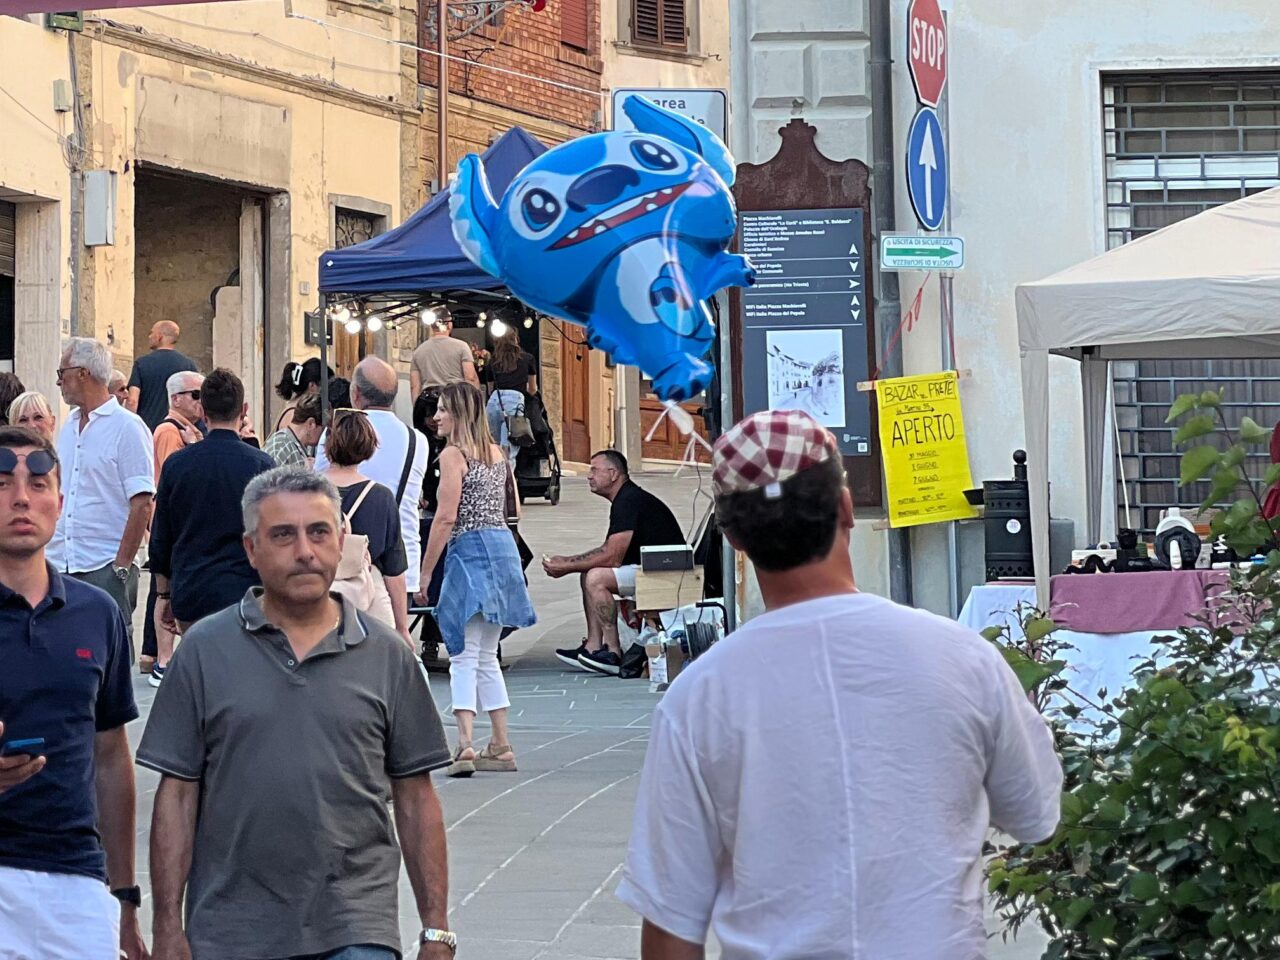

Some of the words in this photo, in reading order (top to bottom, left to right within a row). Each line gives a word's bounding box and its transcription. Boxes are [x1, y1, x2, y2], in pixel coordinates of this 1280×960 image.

[912, 17, 945, 71] STOP
[884, 384, 920, 403] BAZAR
[928, 380, 953, 398] PRETE
[891, 413, 955, 448] APERTO
